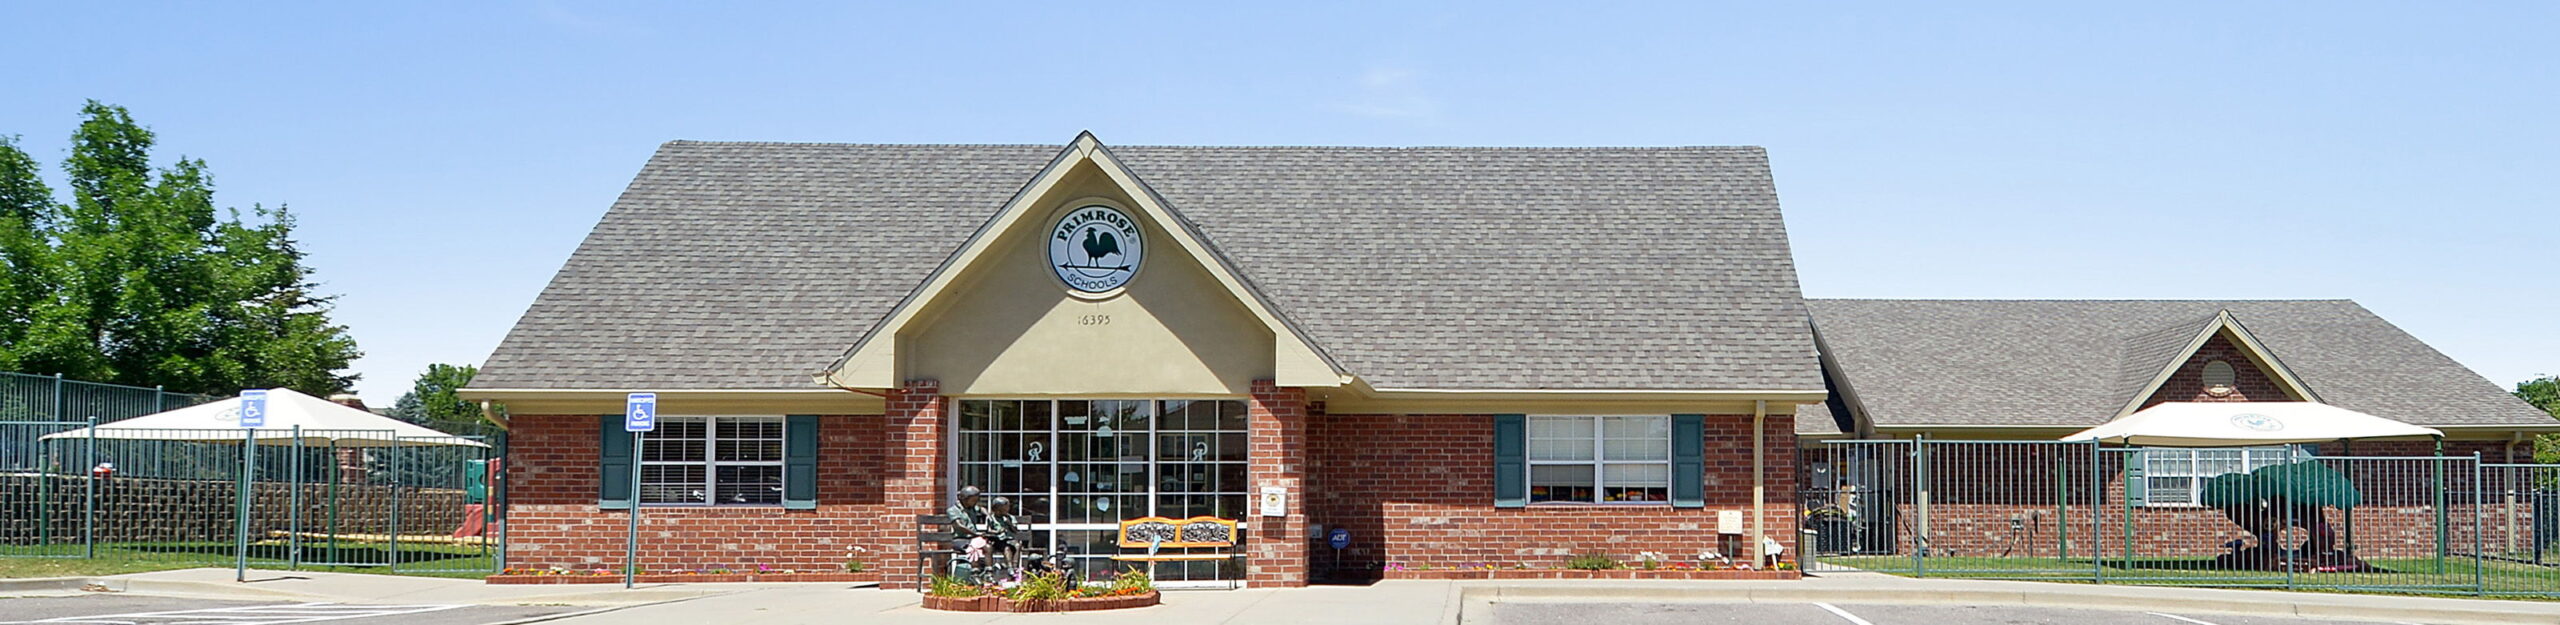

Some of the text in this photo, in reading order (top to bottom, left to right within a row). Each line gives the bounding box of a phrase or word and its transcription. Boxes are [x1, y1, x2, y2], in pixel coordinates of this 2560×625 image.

[1056, 210, 1135, 242] PRIMROSE
[1067, 273, 1118, 289] SCHOOLS
[1078, 314, 1111, 326] 16395
[1331, 534, 1347, 542] ADT
